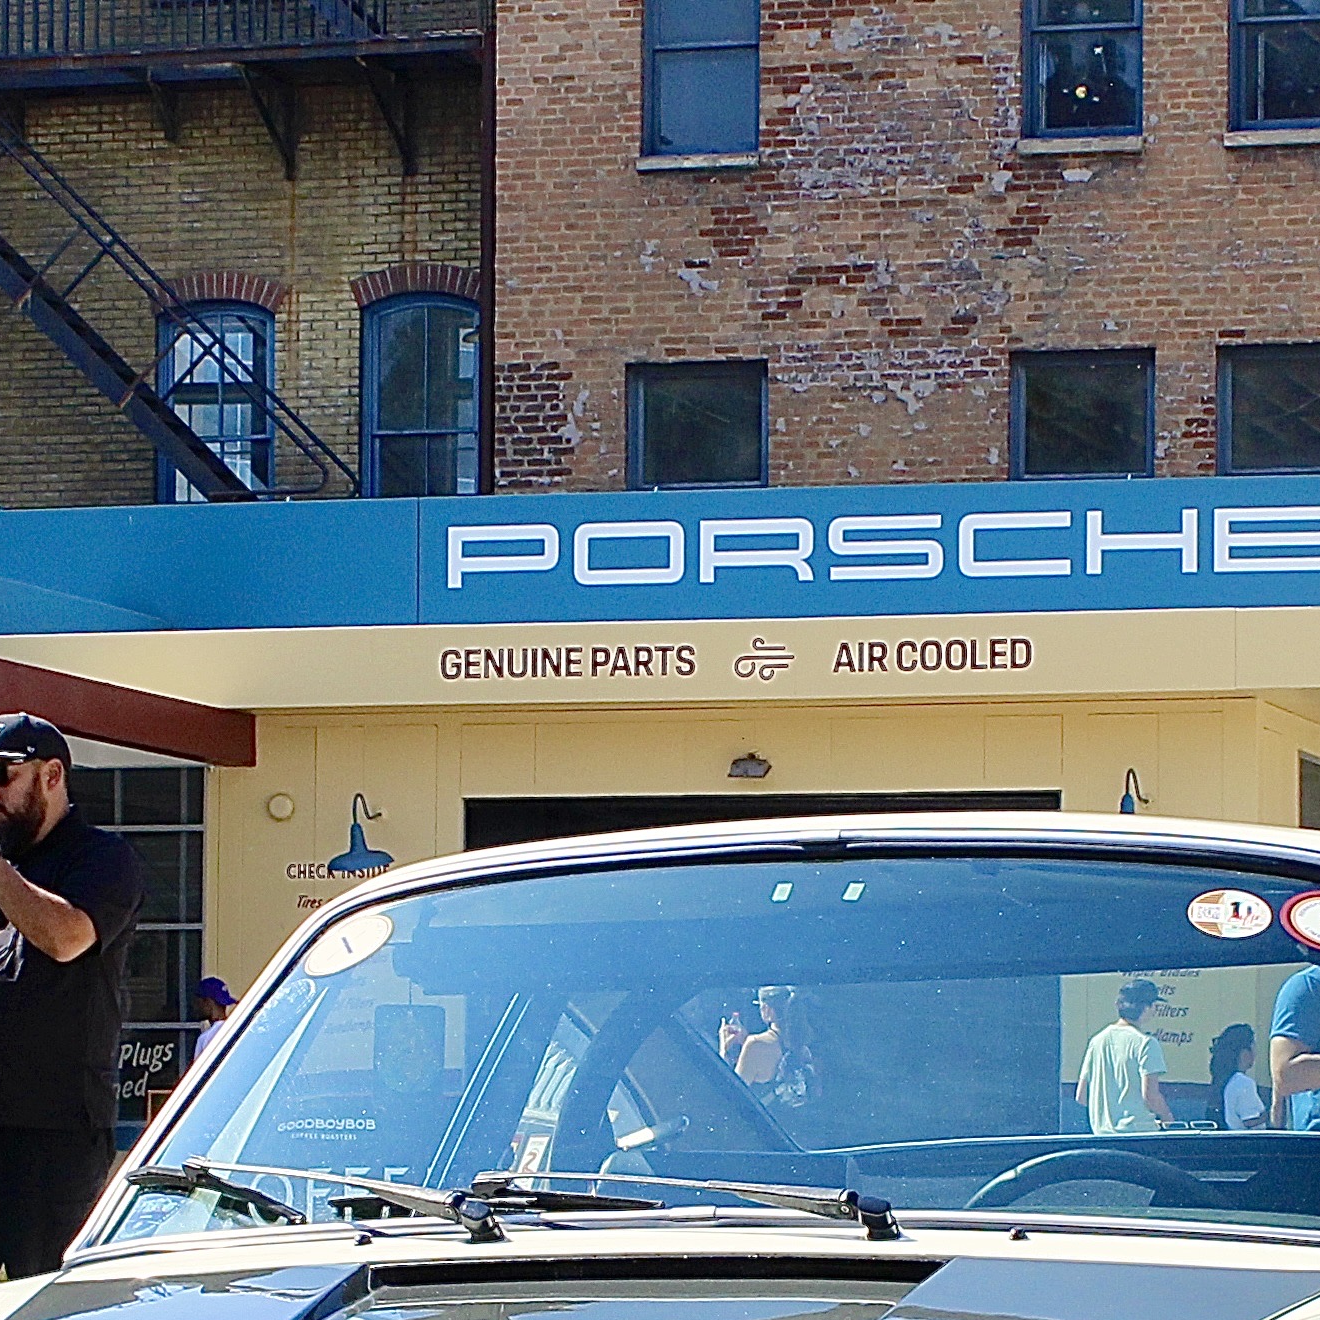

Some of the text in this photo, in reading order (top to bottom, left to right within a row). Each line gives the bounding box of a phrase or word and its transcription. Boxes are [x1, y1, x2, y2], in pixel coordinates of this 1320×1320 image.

[440, 645, 696, 680] GENUINE PARTS
[833, 638, 1033, 672] AIR COOLED
[296, 894, 323, 910] Tires
[118, 1042, 175, 1073] Plugs
